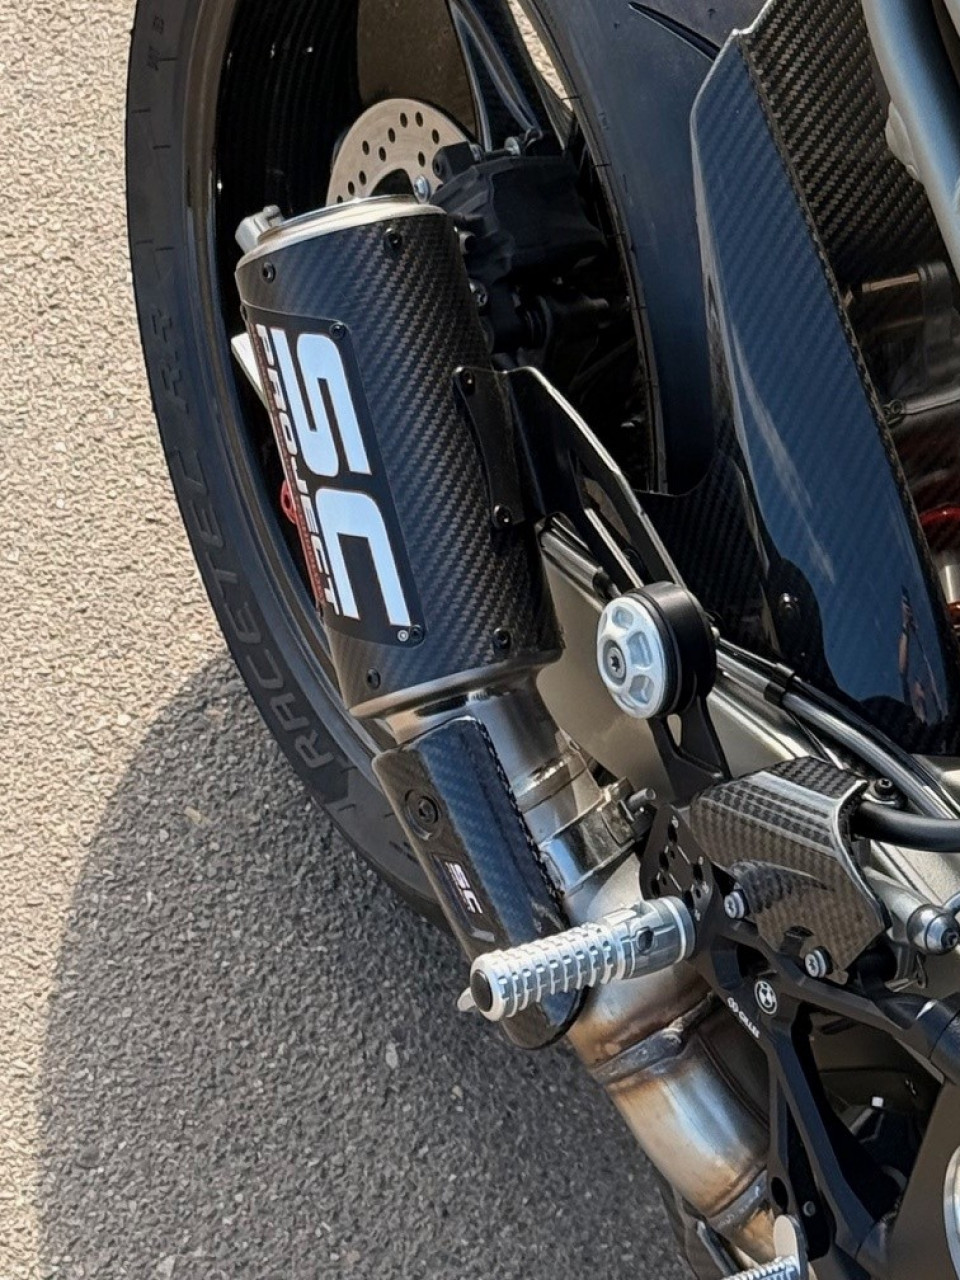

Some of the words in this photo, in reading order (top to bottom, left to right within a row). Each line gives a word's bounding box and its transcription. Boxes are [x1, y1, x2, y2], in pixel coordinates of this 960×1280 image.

[174, 447, 335, 770] RACETEC
[255, 323, 340, 616] PROJECT
[269, 326, 412, 627] SC
